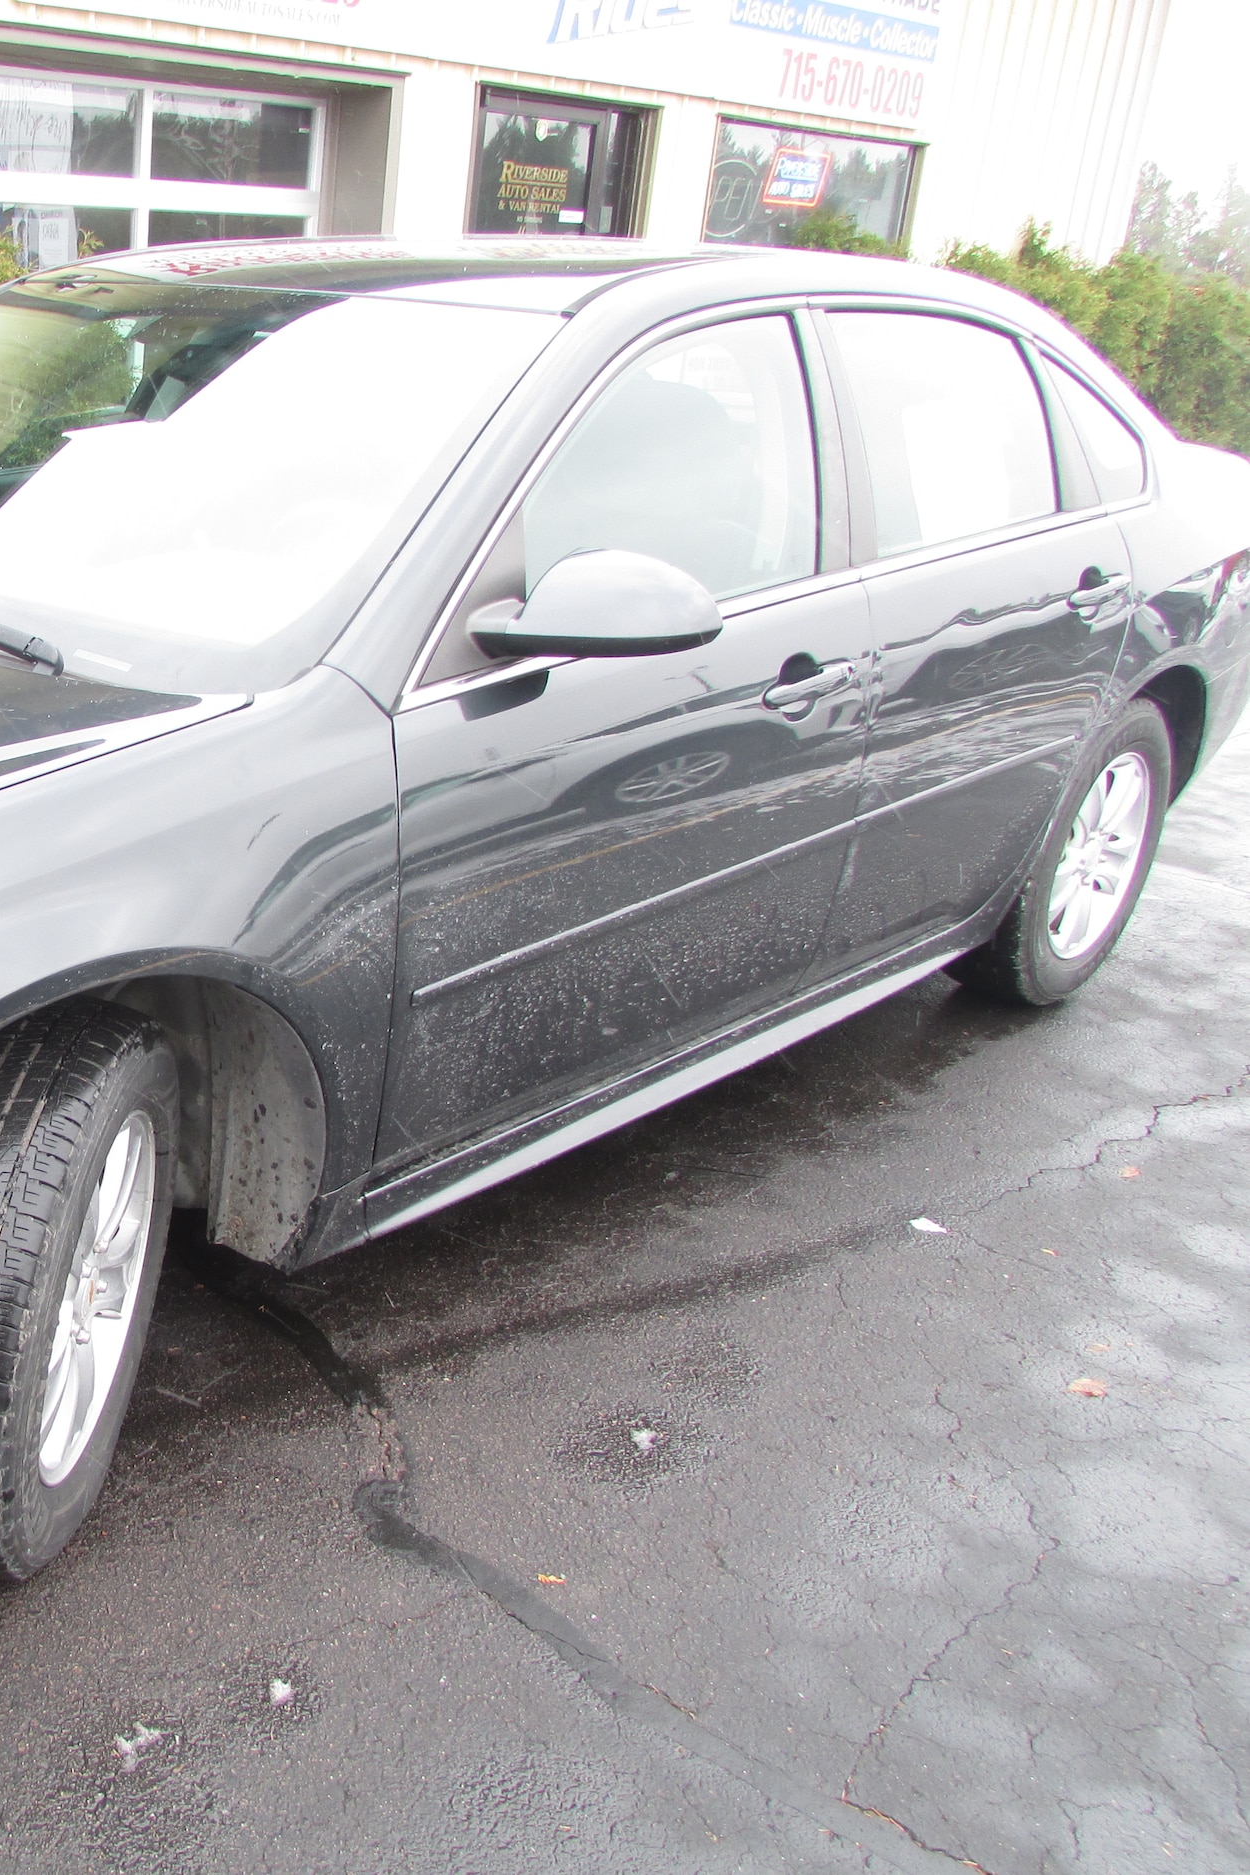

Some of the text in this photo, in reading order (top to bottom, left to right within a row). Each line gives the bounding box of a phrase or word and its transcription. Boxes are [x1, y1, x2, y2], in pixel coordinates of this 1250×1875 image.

[778, 47, 924, 119] 715-670-0209
[499, 161, 569, 183] RIVERSIDE
[497, 184, 567, 203] AUTO SALES
[498, 200, 506, 211] &
[509, 200, 527, 212] VAN
